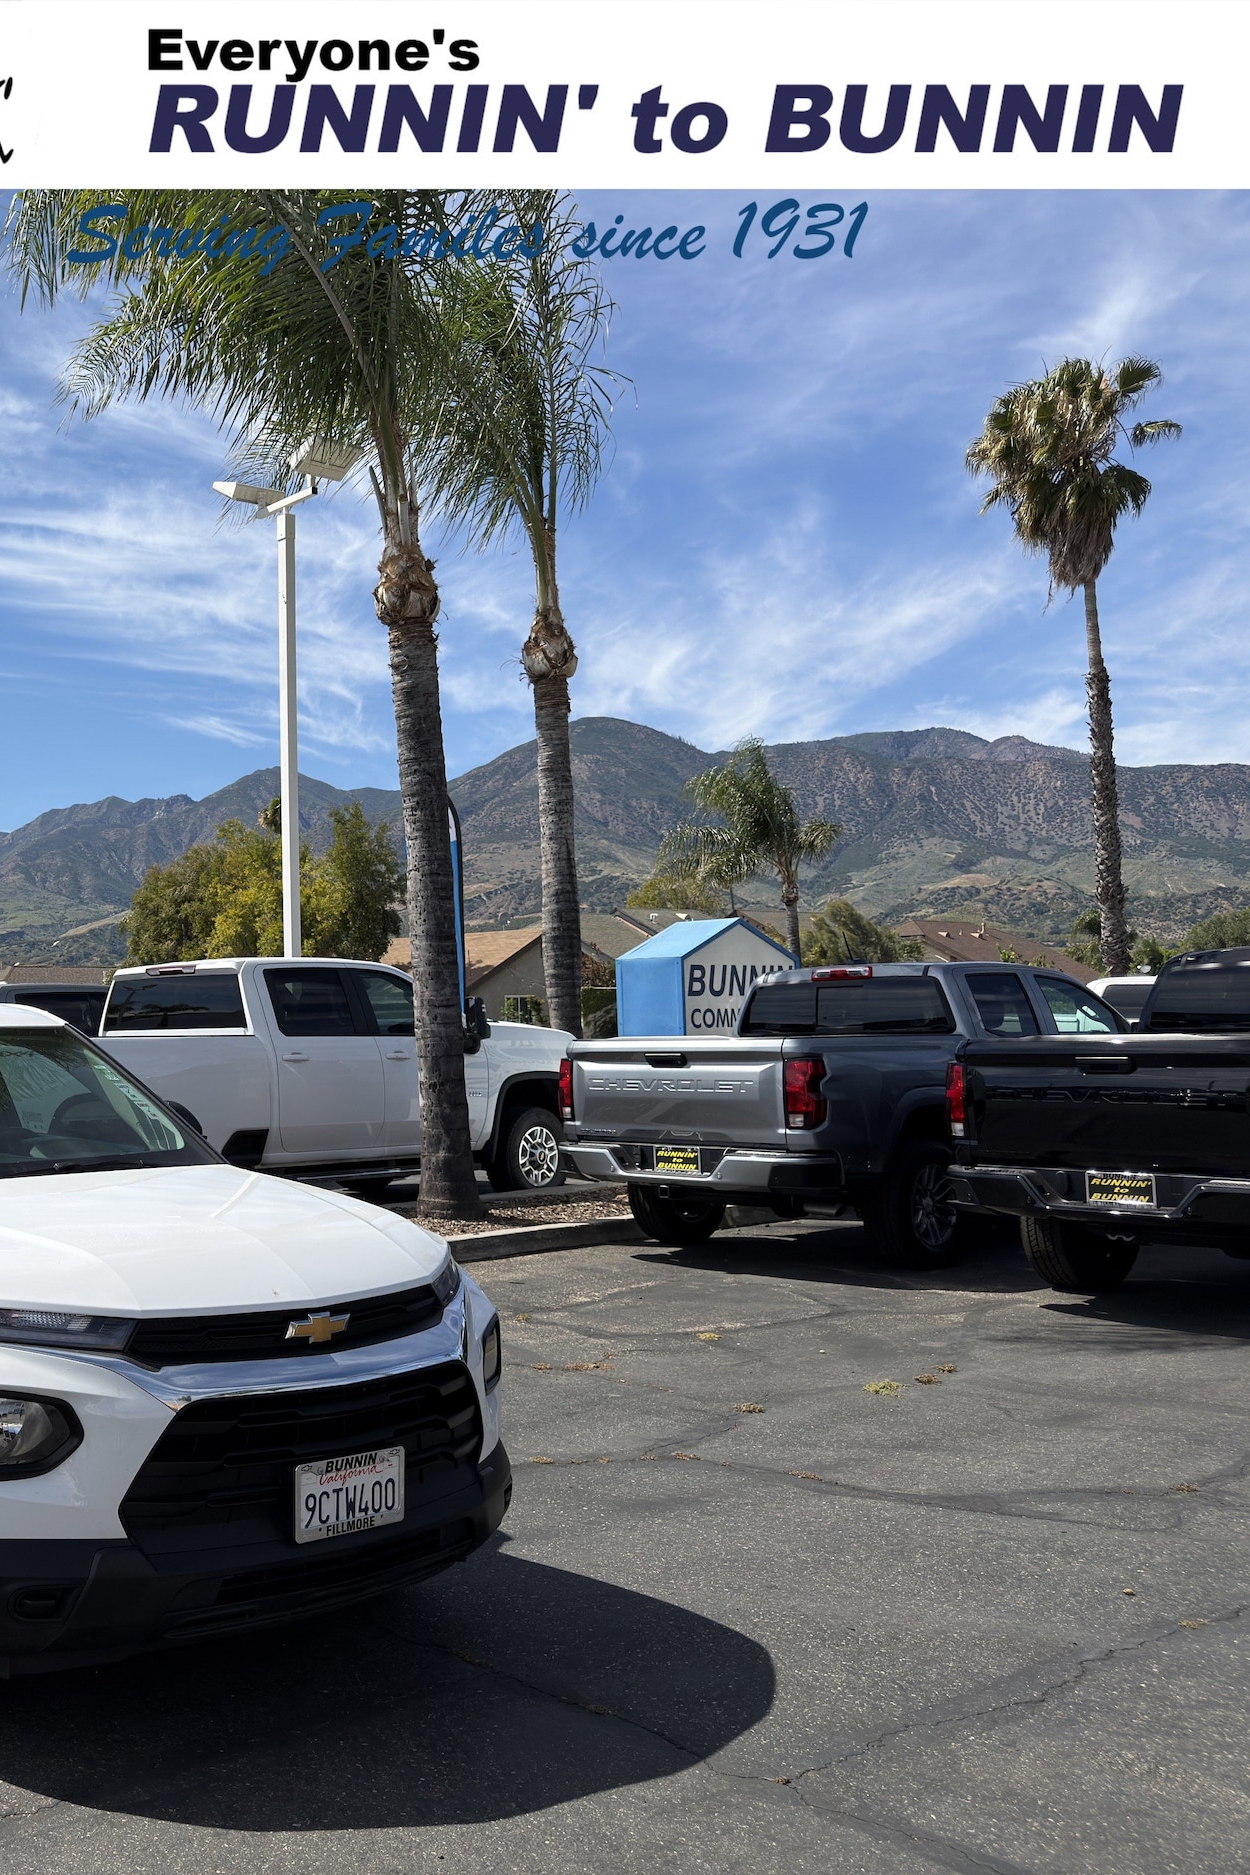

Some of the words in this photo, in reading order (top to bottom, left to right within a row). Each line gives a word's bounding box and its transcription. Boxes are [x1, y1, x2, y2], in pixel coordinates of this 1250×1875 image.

[687, 964, 793, 997] BUN
[588, 1078, 754, 1093] CHEVROLET
[657, 1150, 698, 1158] RUNNIN'
[657, 1162, 697, 1170] BUNNIN
[1091, 1178, 1152, 1187] RUNNIN'
[1091, 1192, 1150, 1202] BUNNIN
[325, 1452, 378, 1473] BUNNIN
[319, 1465, 383, 1487] California
[305, 1478, 396, 1529] 9CTW400
[326, 1516, 375, 1537] FILLMORE
